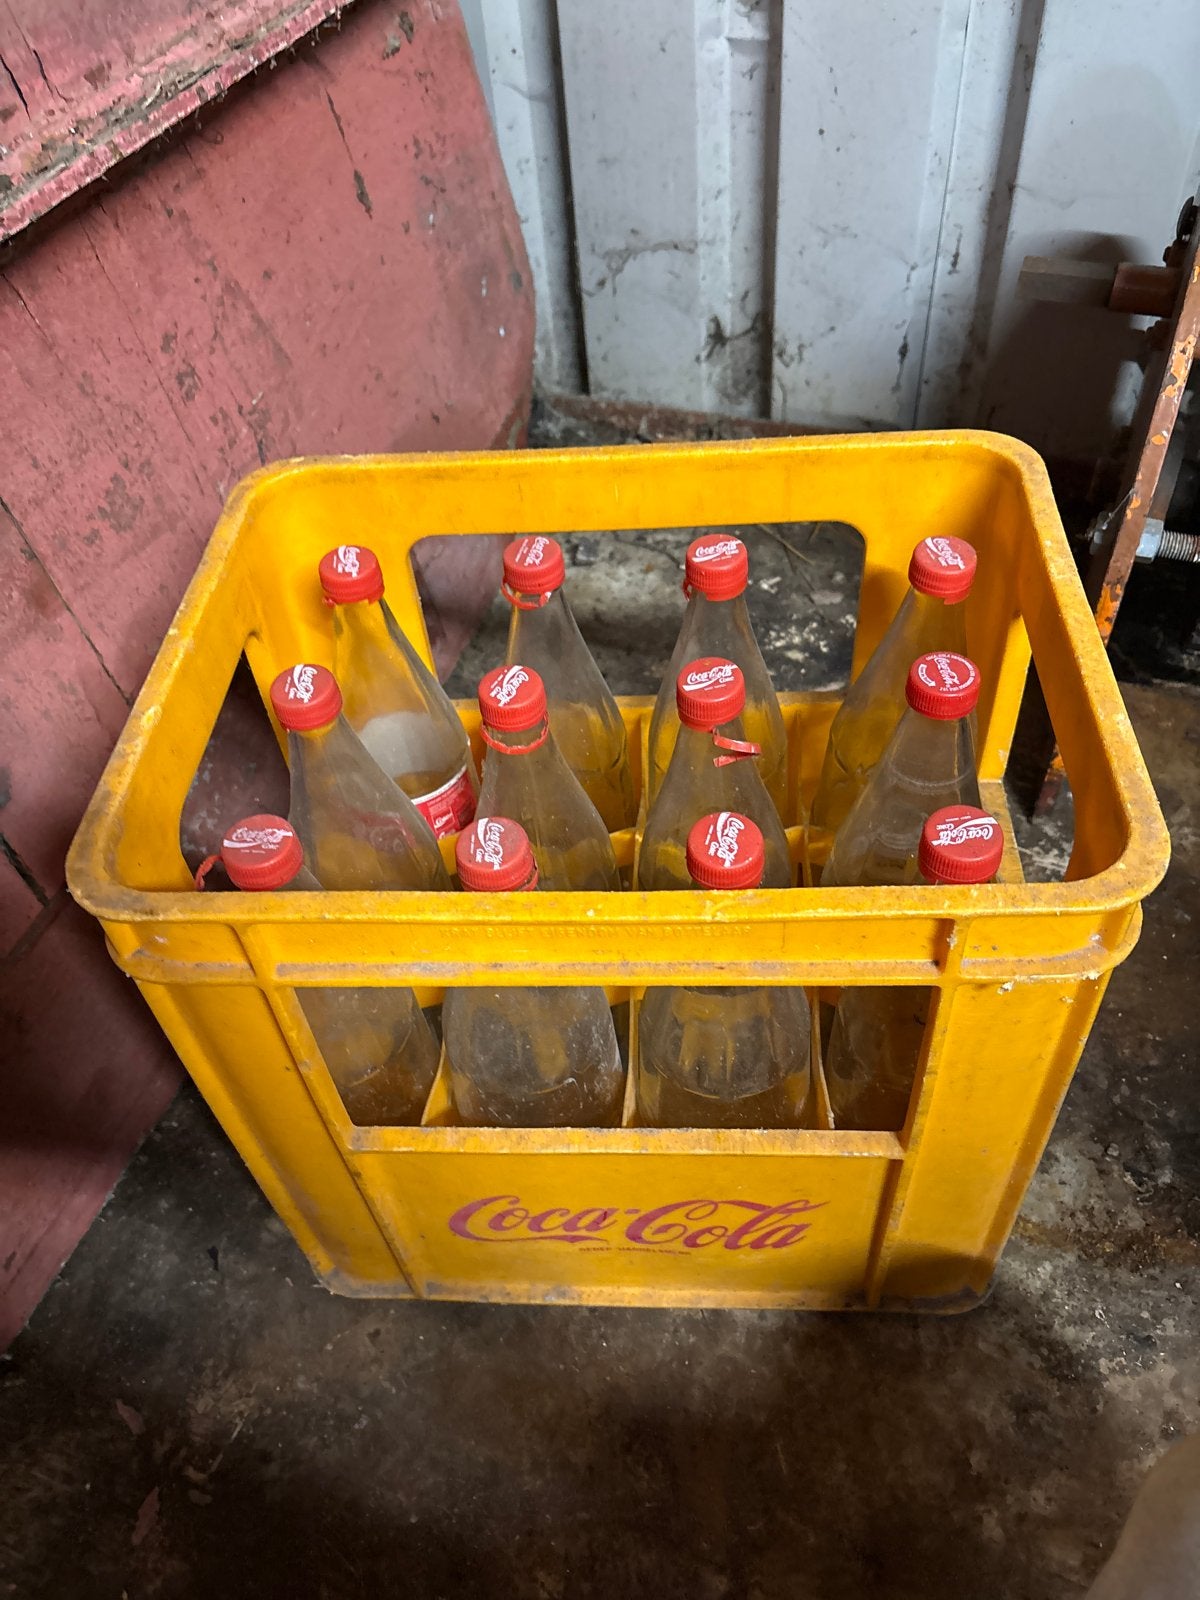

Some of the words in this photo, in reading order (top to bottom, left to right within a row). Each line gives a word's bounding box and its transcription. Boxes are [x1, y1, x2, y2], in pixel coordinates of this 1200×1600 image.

[695, 541, 741, 558] Coca-Cola
[497, 671, 529, 707] Coca-Cola
[687, 664, 737, 685] Coca-Cola
[484, 823, 504, 870] Coca-Cola
[717, 818, 745, 867] Coca-Cola
[931, 825, 993, 846] Coca-Cola
[448, 1195, 831, 1250] Coca-Cola
